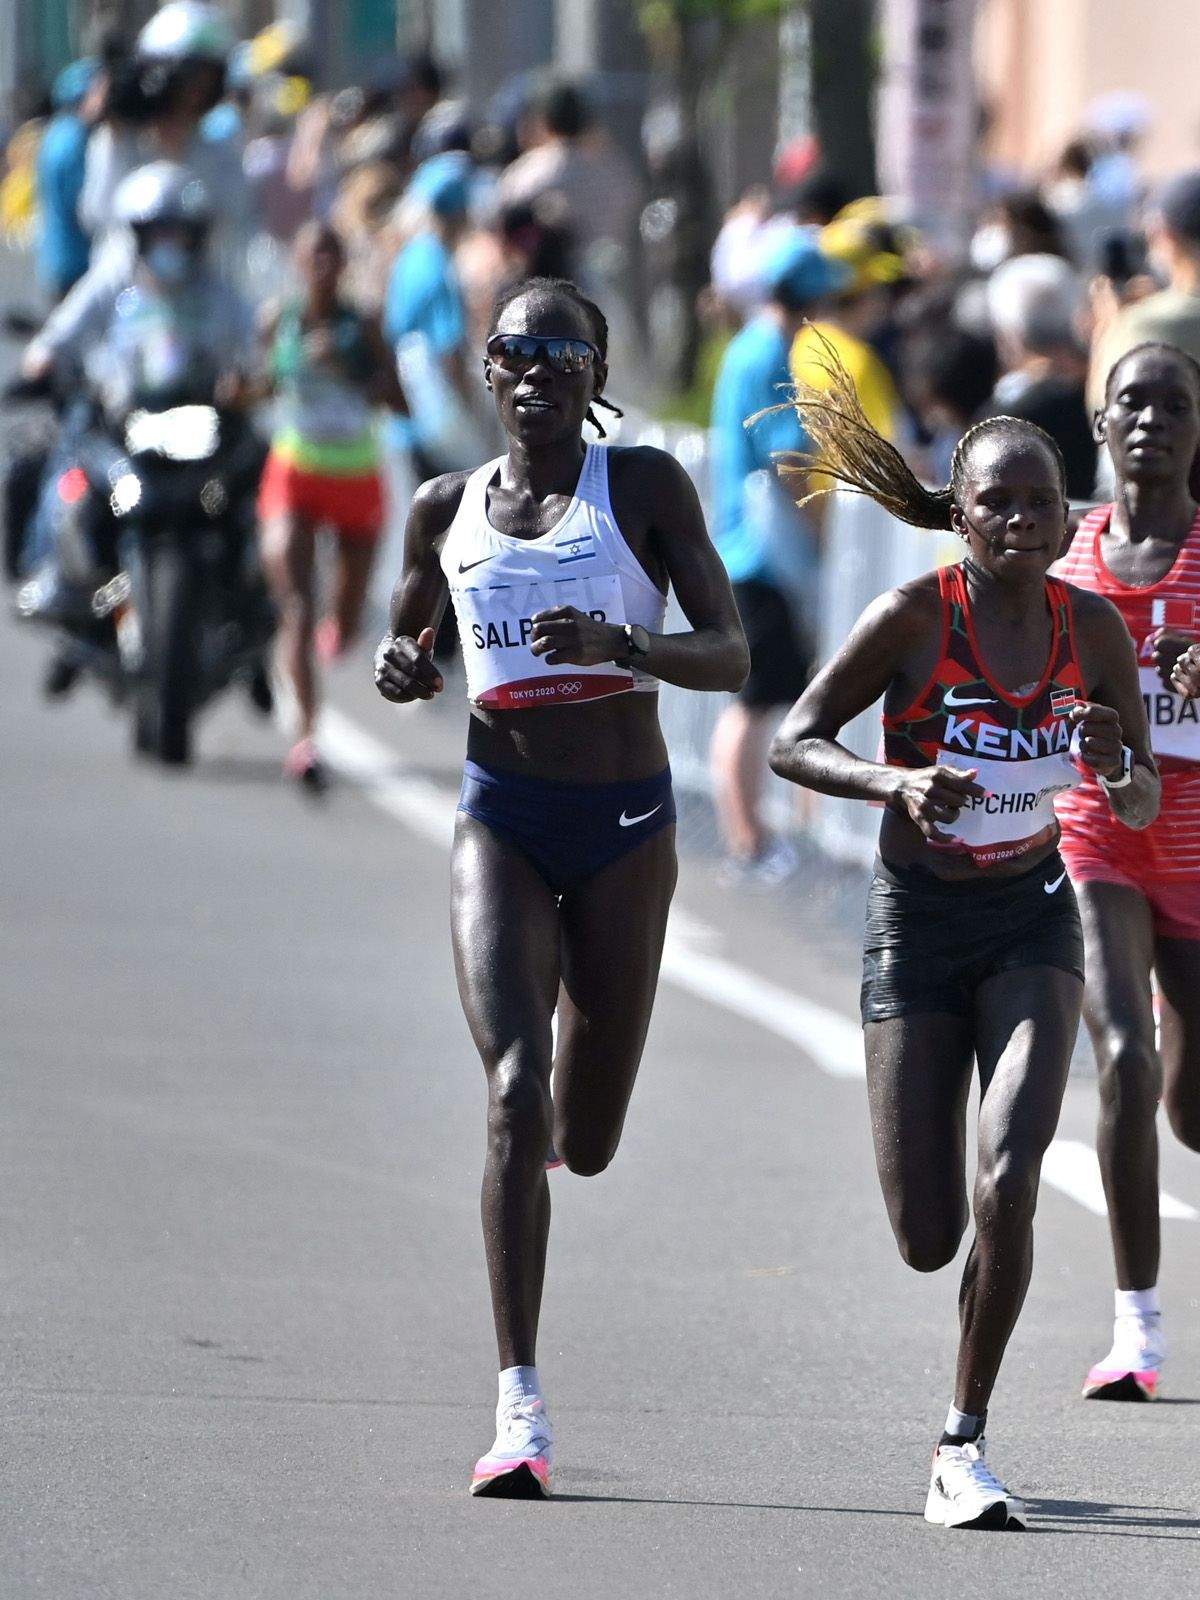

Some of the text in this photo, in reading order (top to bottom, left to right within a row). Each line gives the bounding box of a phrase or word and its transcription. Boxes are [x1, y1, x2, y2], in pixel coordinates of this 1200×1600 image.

[508, 686, 555, 700] TOKYO 2020
[943, 714, 1070, 759] KENYA
[972, 849, 1014, 861] TOKYO 2020
